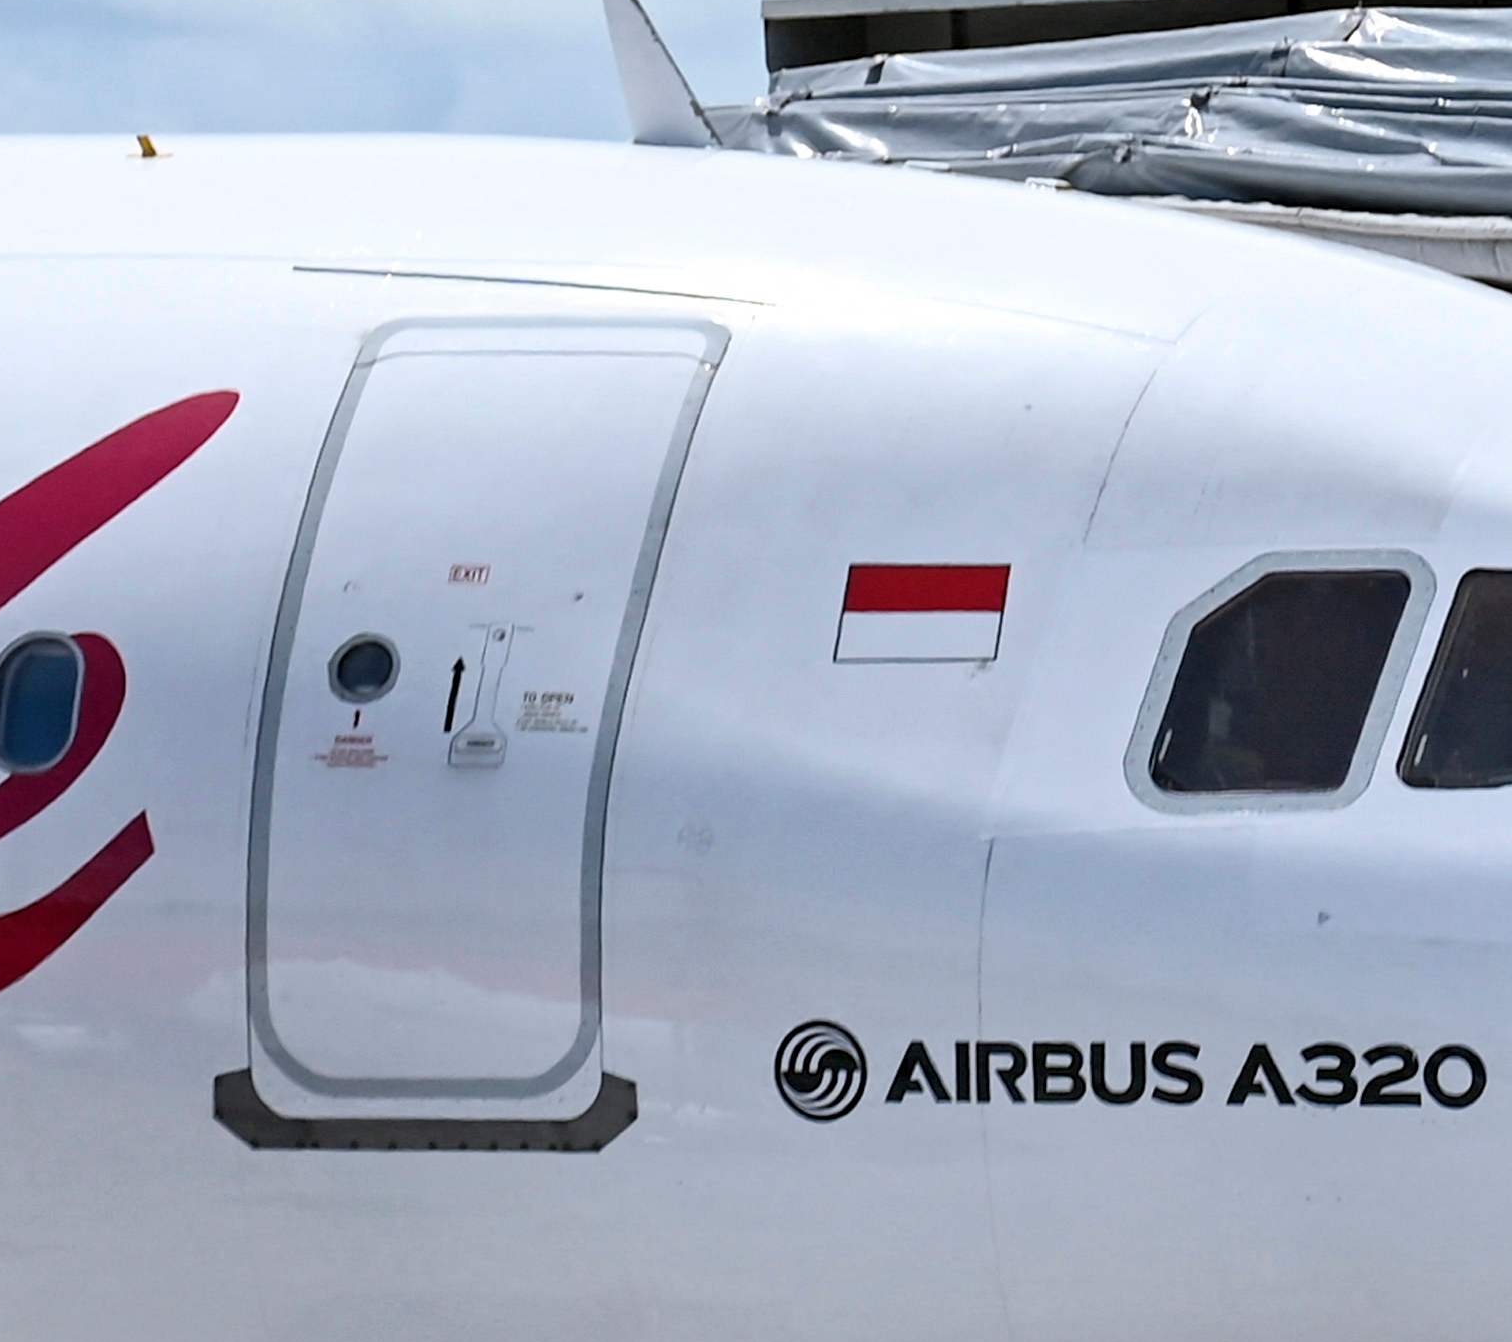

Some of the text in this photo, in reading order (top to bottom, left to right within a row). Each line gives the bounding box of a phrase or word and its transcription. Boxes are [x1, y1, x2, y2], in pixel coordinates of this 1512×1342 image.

[453, 566, 485, 583] EXIT
[884, 1040, 1488, 1108] AIRBUS A320
